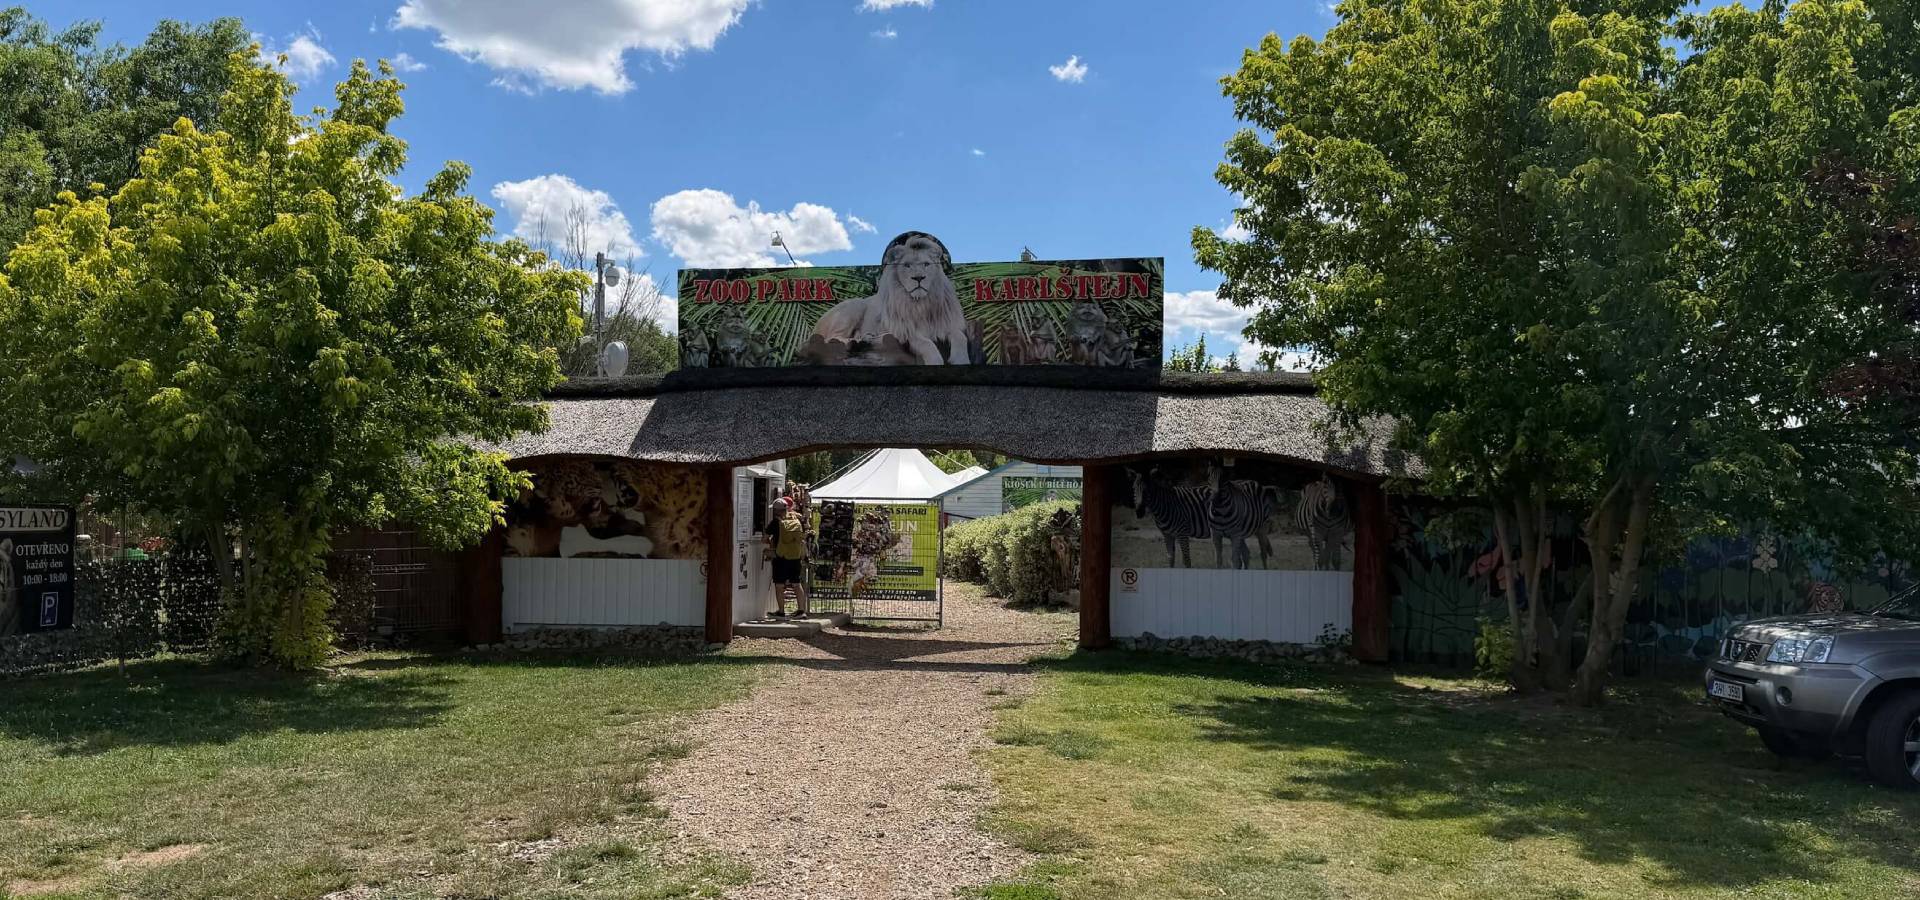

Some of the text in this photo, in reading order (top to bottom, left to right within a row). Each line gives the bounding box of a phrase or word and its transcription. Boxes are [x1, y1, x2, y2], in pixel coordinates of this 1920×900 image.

[694, 269, 1150, 304] ZOO PARK KARLŠTEJN
[896, 507, 928, 516] SAFARI
[16, 542, 69, 556] OTEVŘENO
[26, 559, 64, 571] každý den
[23, 575, 43, 585] 10:00
